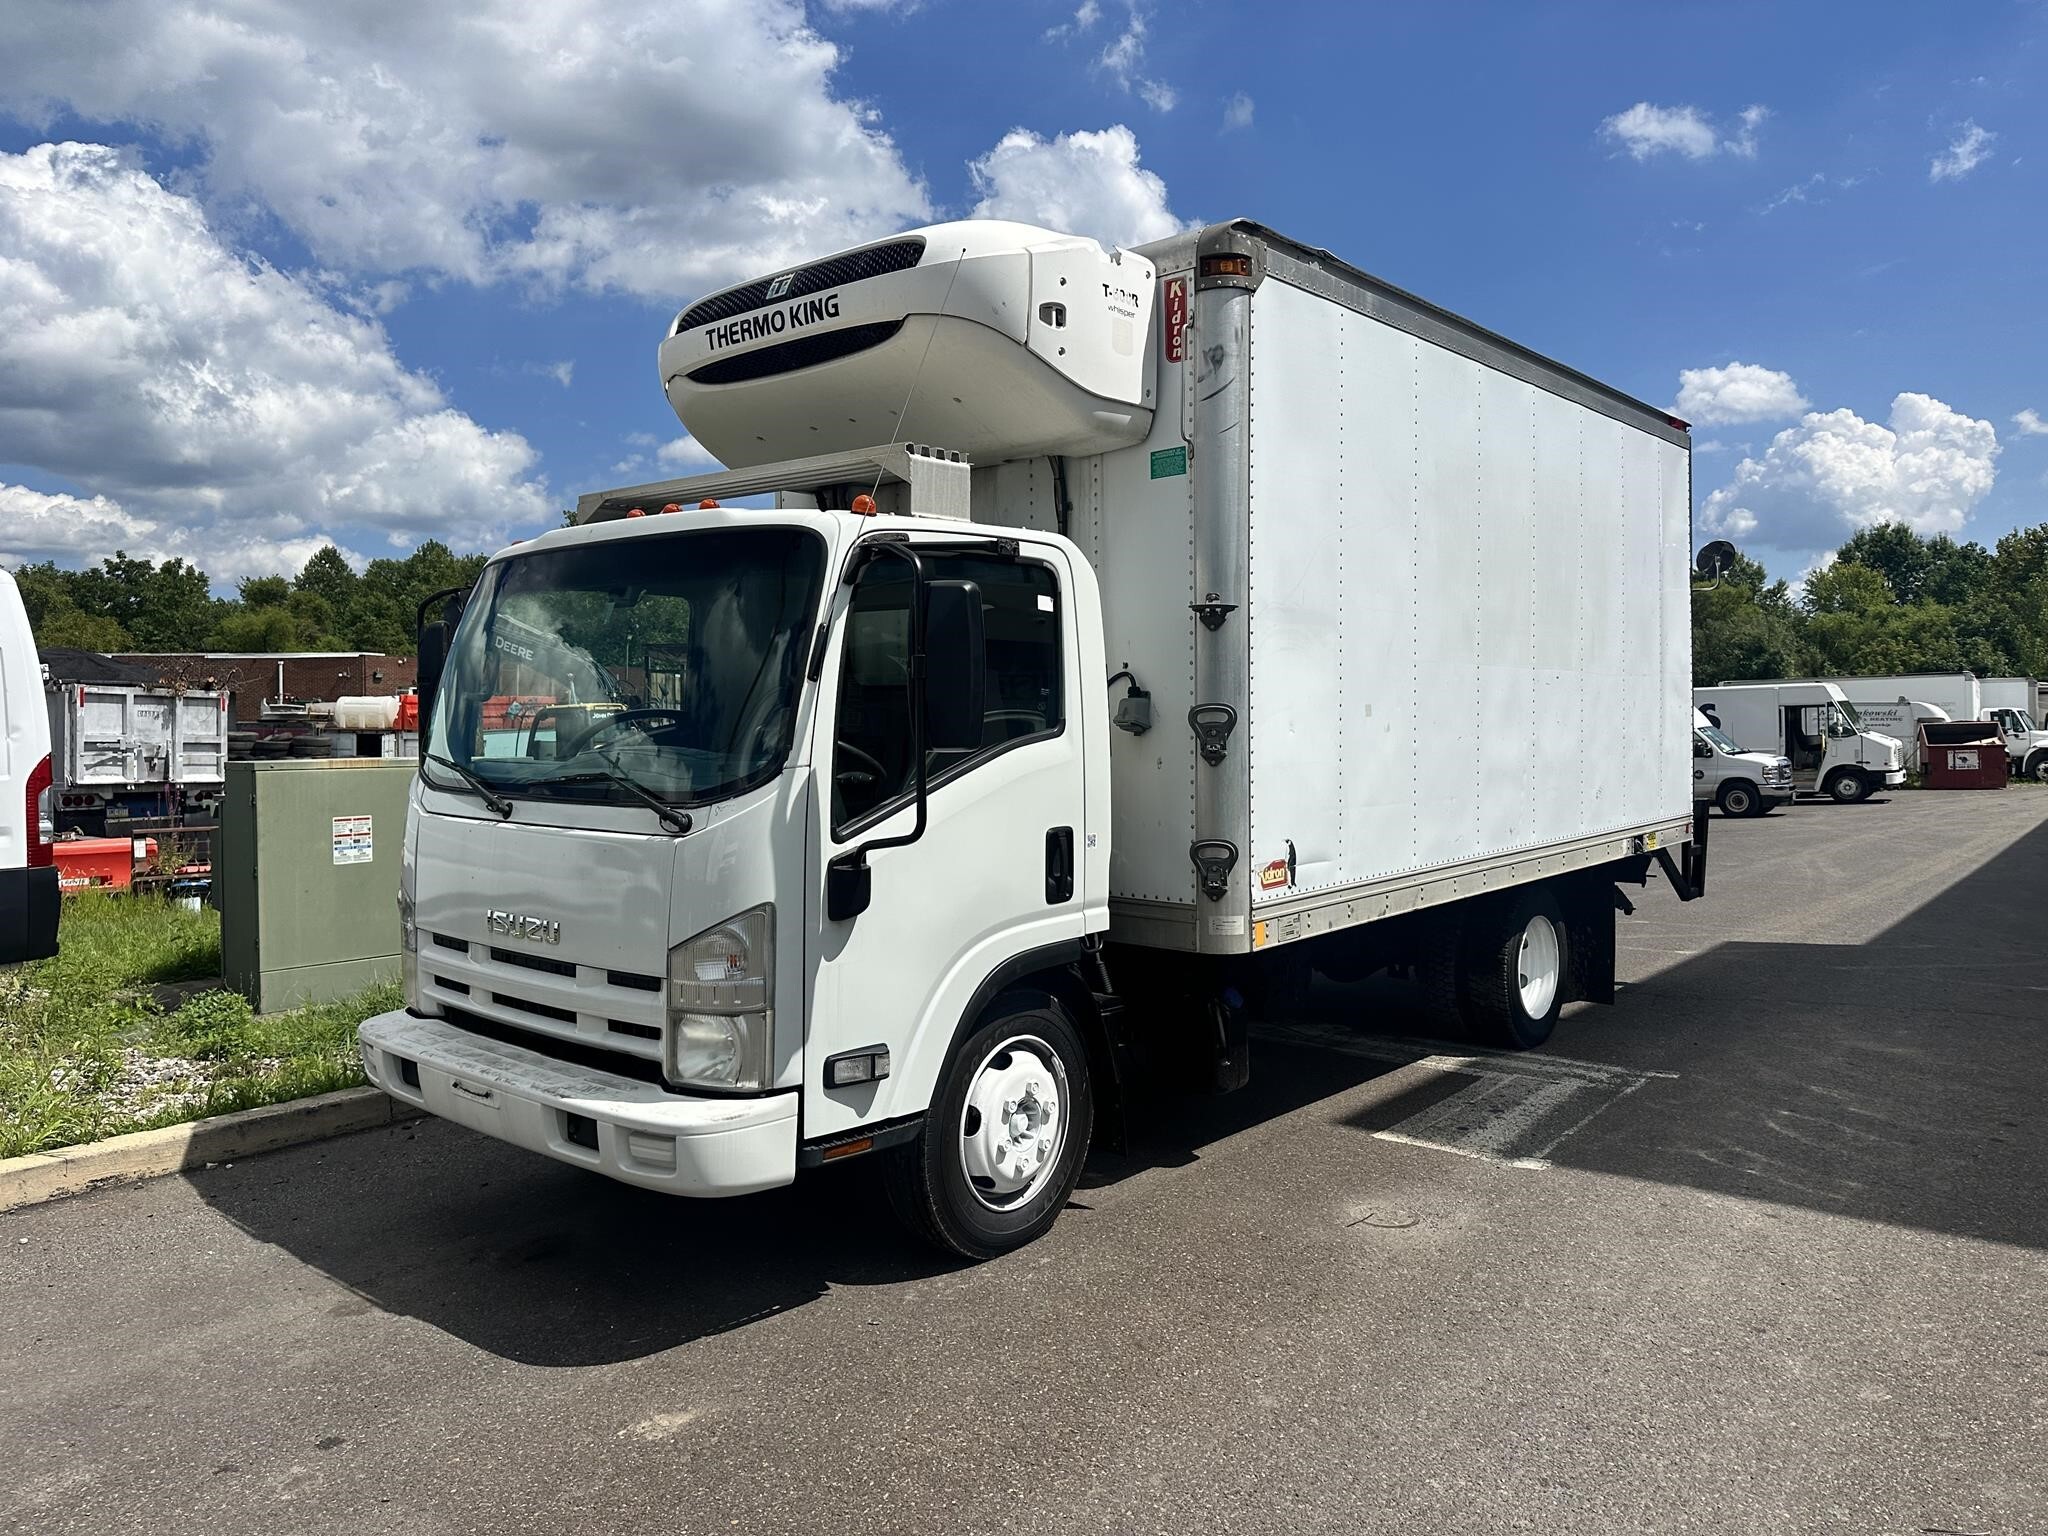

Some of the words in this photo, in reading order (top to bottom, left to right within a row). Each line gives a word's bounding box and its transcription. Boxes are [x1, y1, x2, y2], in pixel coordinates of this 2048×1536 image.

[705, 309, 785, 351] THERMO
[789, 293, 840, 329] KING
[1169, 280, 1182, 357] Kidron
[495, 635, 534, 661] DEERE
[487, 909, 560, 945] ISUZU
